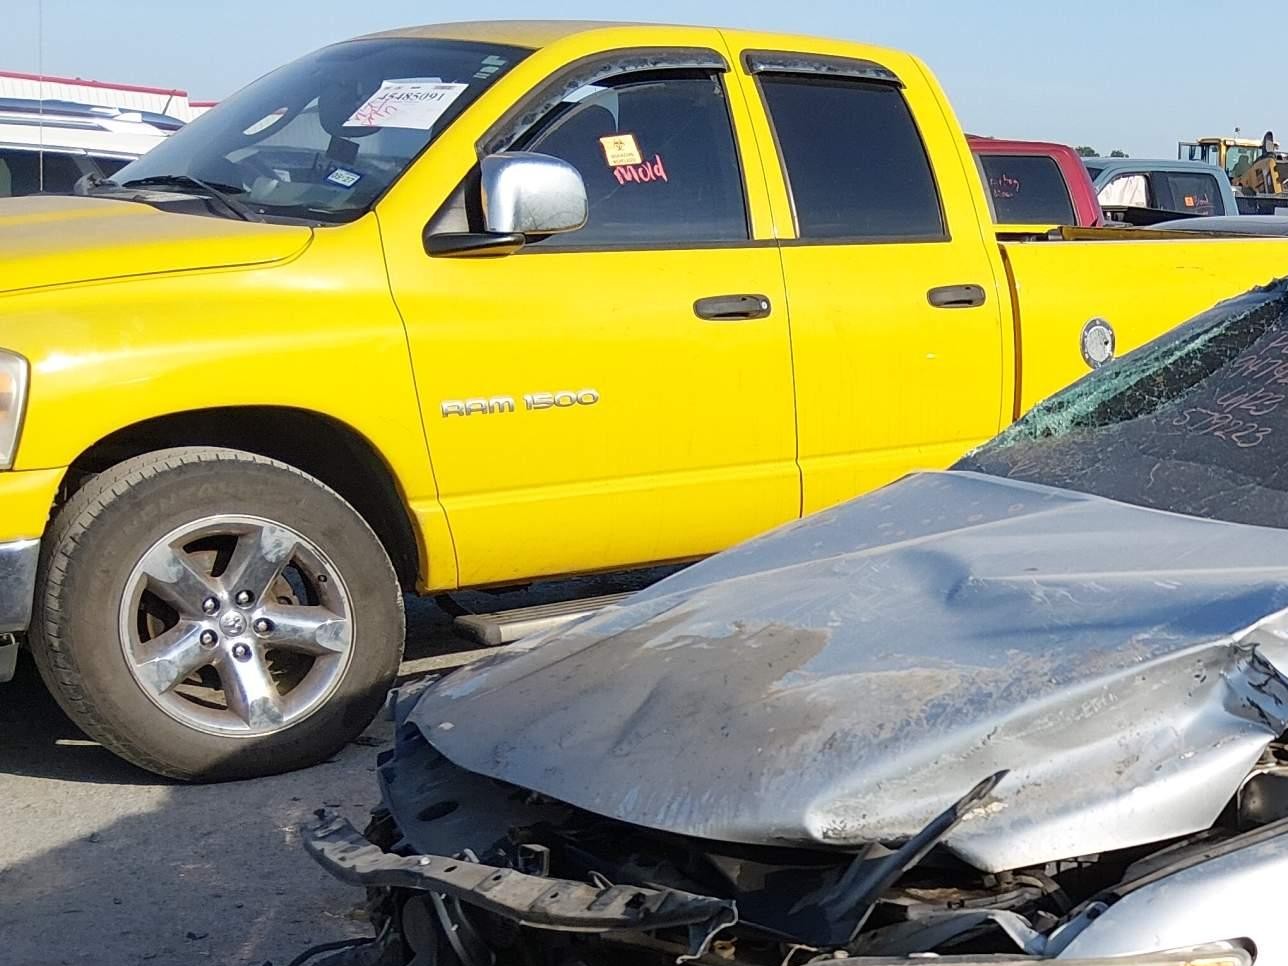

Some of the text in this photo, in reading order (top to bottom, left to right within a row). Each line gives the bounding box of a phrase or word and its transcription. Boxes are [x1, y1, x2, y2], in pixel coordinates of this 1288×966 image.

[377, 92, 447, 102] 45485091
[441, 389, 600, 418] RAM 1500
